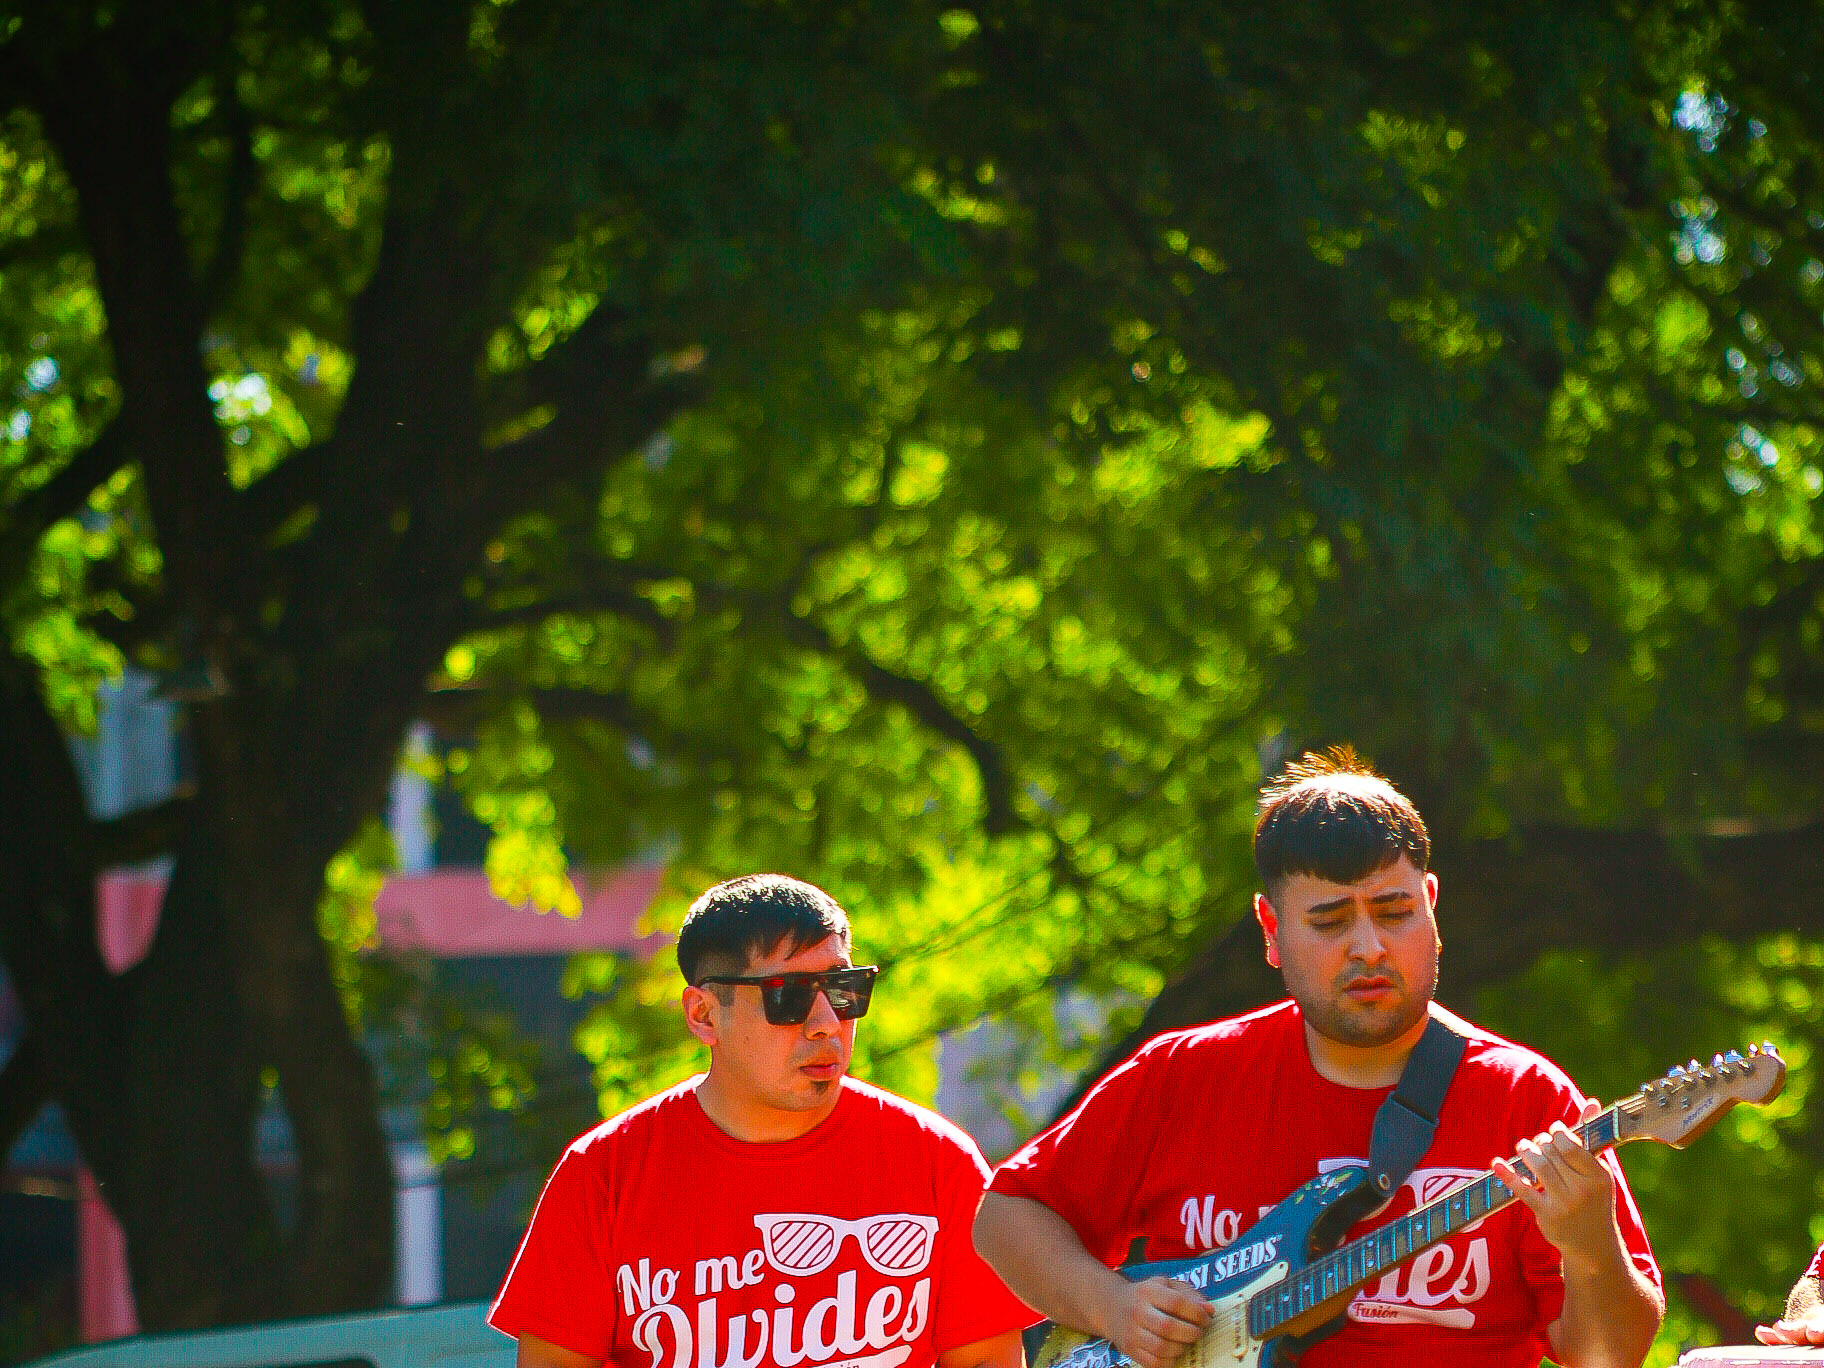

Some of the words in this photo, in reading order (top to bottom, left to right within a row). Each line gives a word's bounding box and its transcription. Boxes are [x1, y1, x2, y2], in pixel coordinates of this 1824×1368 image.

[1180, 1195, 1242, 1249] No
[616, 1257, 680, 1316] No
[694, 1249, 766, 1296] me
[1214, 1237, 1278, 1282] SEEDS
